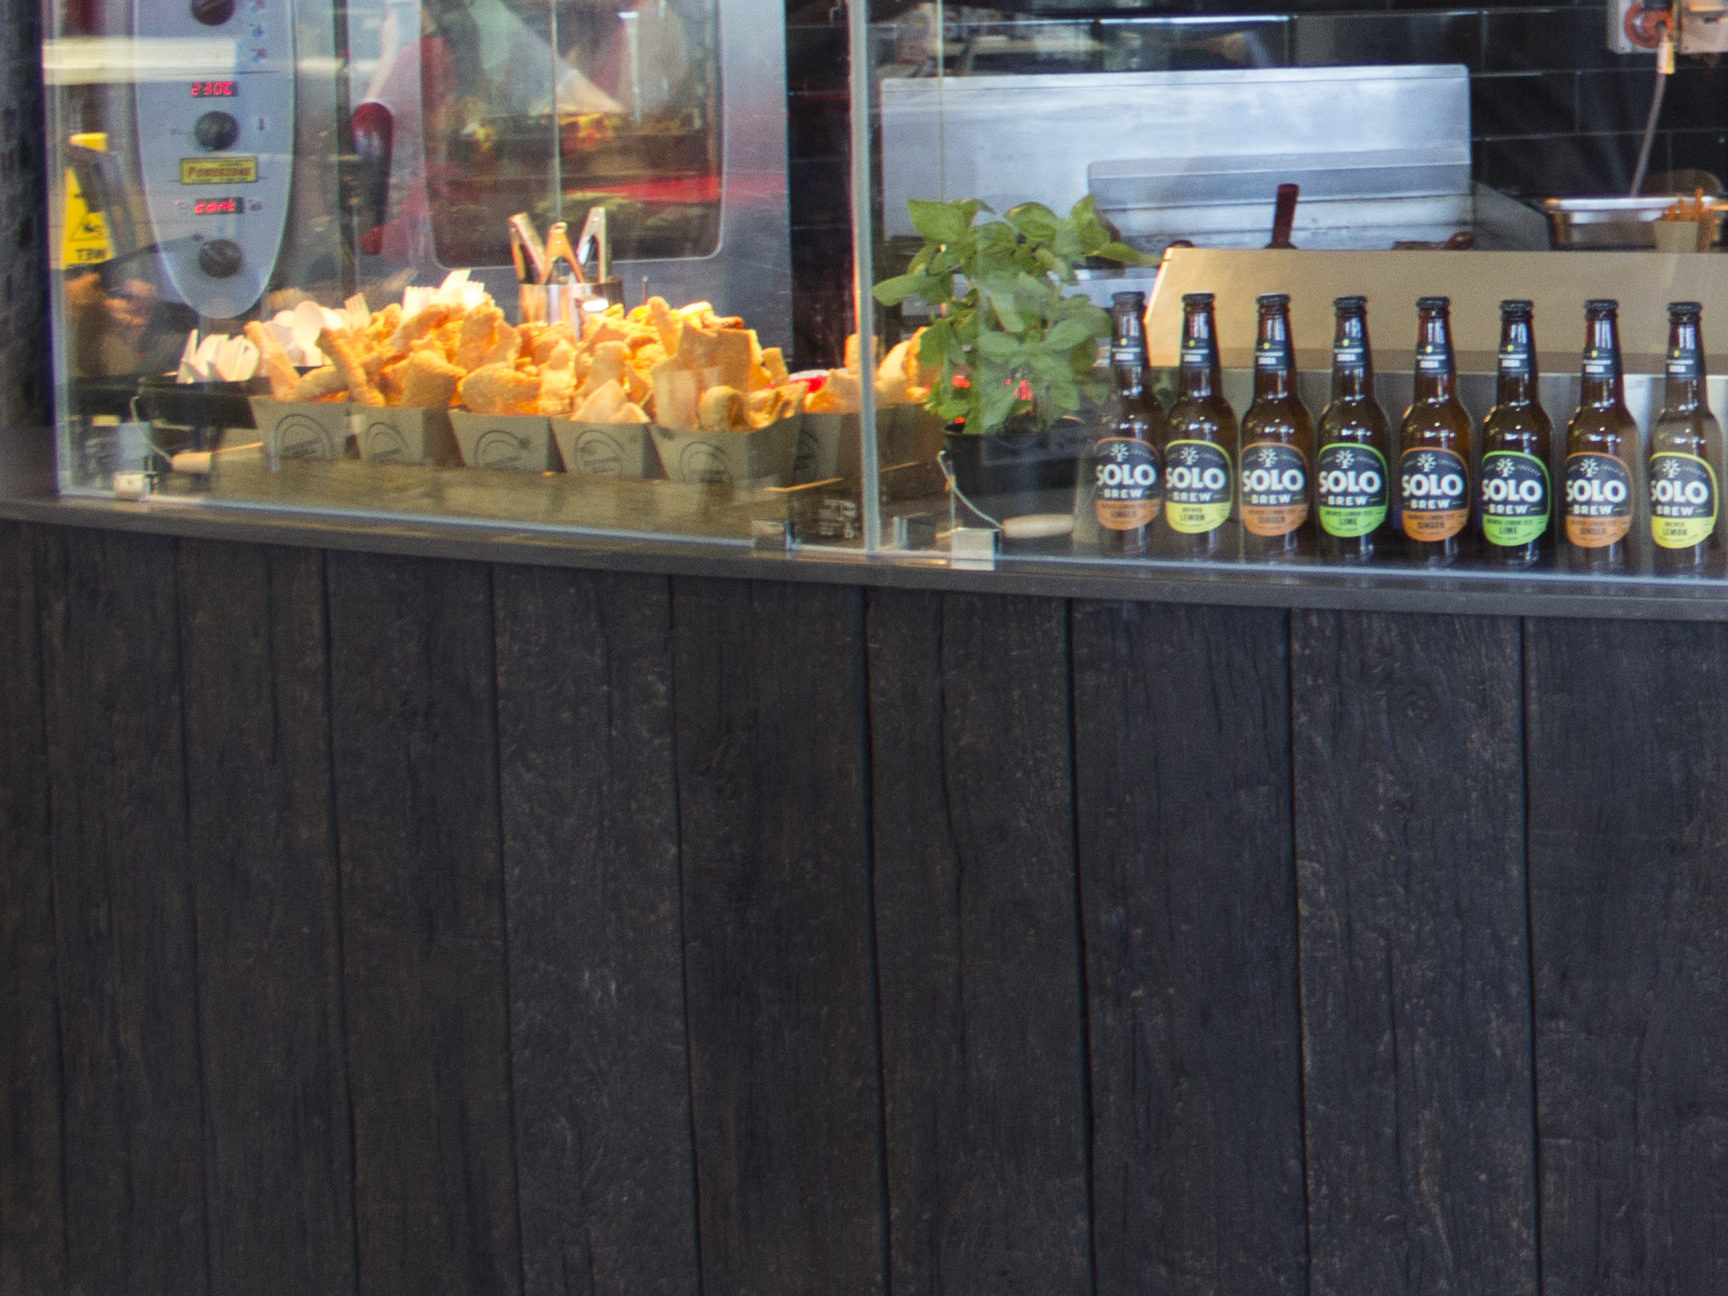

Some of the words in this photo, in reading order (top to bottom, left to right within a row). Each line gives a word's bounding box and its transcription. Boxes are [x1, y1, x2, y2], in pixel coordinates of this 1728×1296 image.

[1097, 464, 1157, 486] SOLO
[1165, 467, 1226, 490] SOLO
[1243, 469, 1304, 492] SOLO
[1319, 470, 1381, 494] SOLO
[1103, 488, 1145, 499] BREW
[1402, 474, 1463, 497] SOLO
[1481, 480, 1543, 502] SOLO
[1566, 480, 1627, 503] SOLO
[1650, 480, 1709, 503] SOLO
[1172, 491, 1212, 503] BREW
[1252, 494, 1292, 505] BREW
[1327, 495, 1369, 506] BREW
[1410, 499, 1450, 510] BREW
[1489, 504, 1529, 514] BREW
[1573, 505, 1613, 516] BREW
[1656, 506, 1694, 517] BREW
